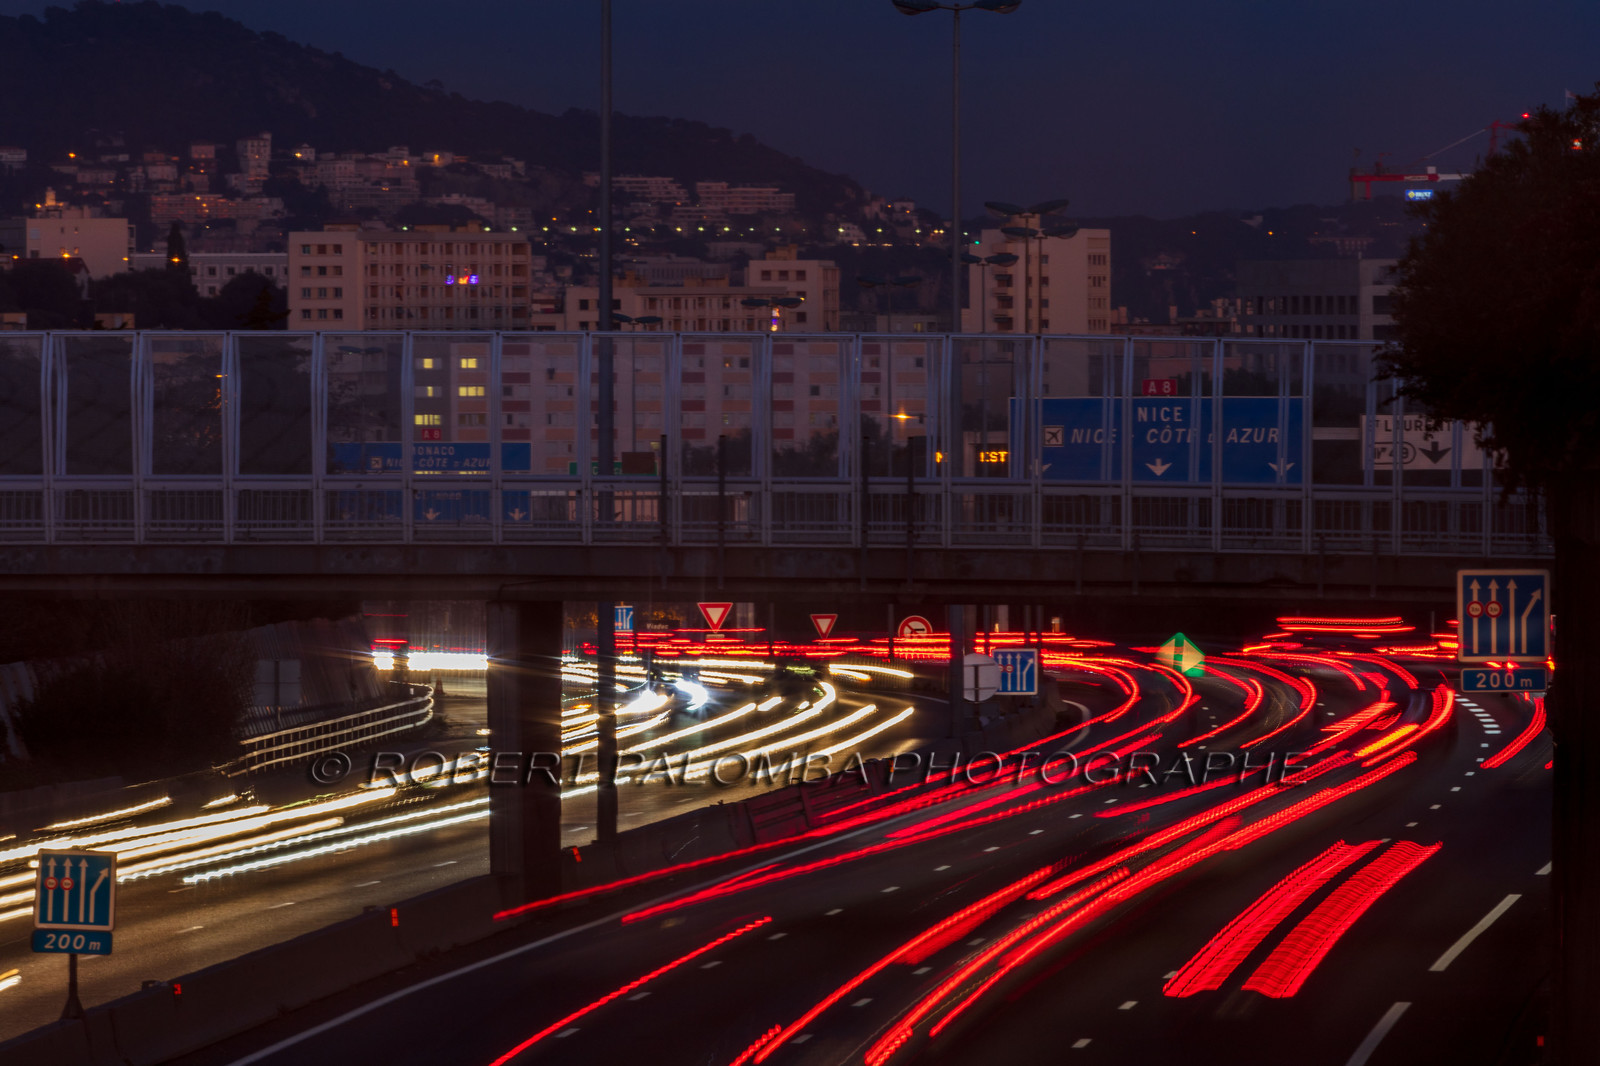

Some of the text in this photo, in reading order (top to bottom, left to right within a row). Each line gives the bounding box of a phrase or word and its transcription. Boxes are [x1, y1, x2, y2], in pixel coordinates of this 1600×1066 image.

[1136, 406, 1184, 422] NICE
[1070, 427, 1118, 444] NICE
[1475, 672, 1533, 688] 200 m
[43, 933, 102, 951] 200 m
